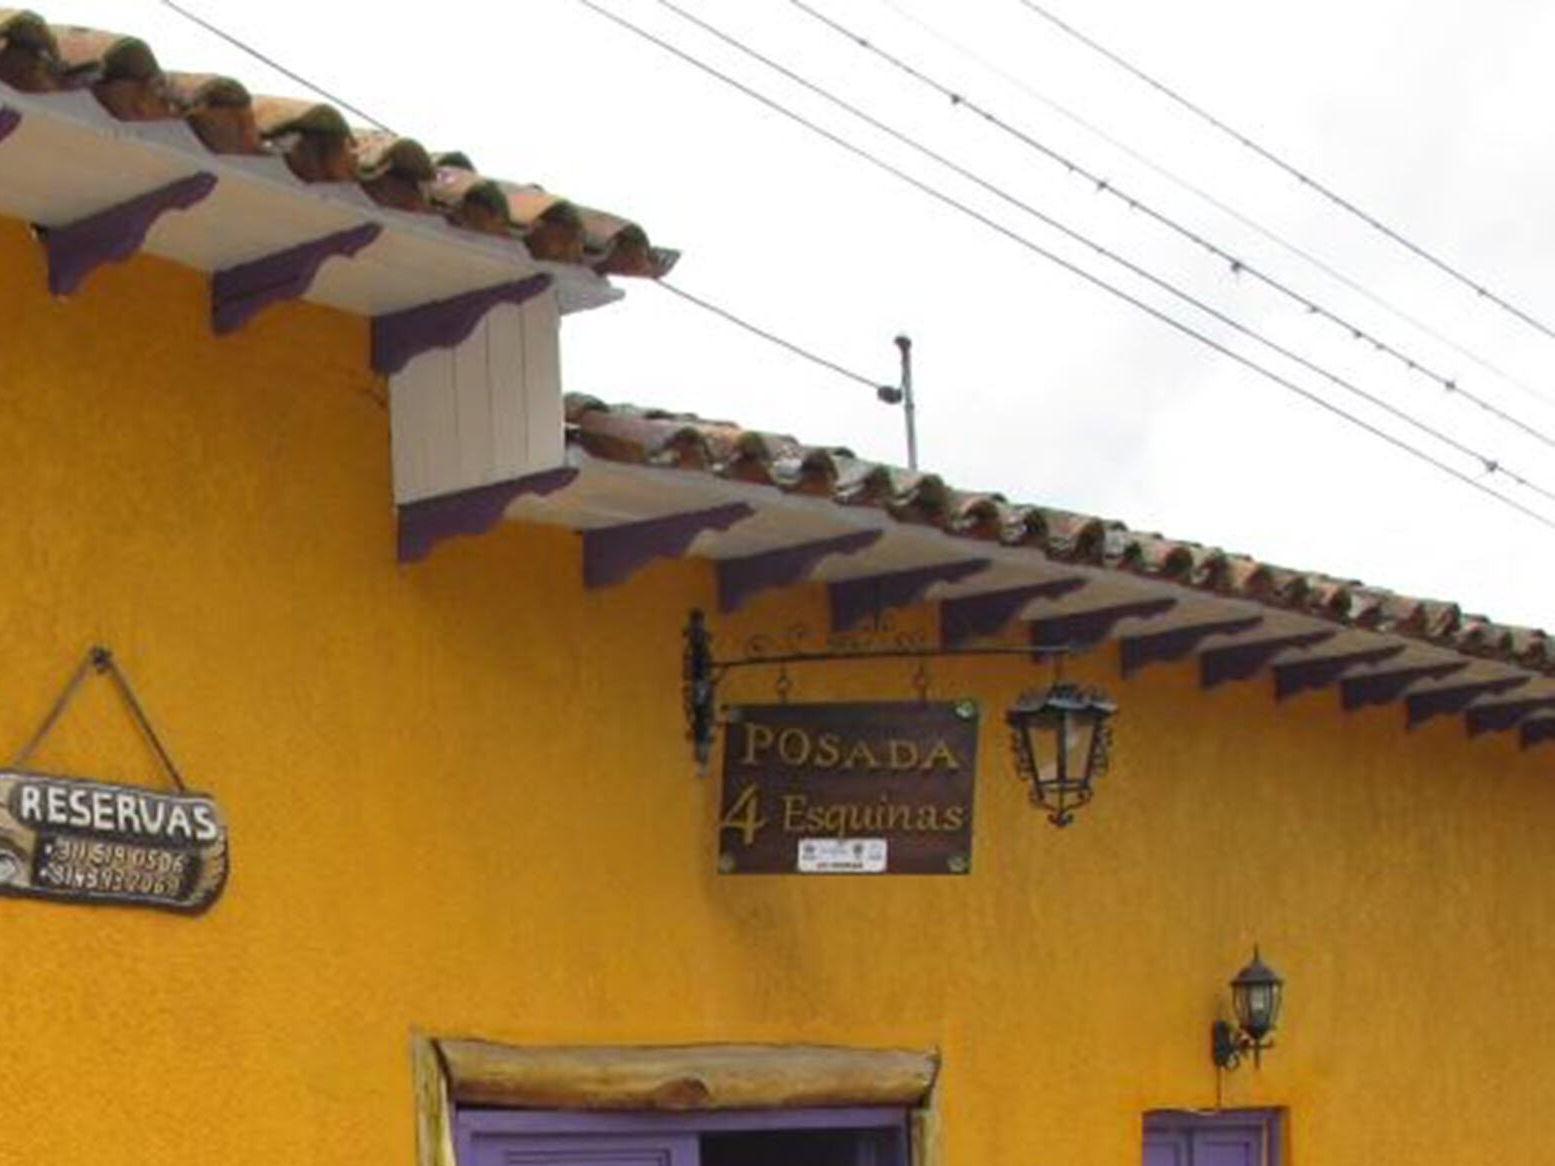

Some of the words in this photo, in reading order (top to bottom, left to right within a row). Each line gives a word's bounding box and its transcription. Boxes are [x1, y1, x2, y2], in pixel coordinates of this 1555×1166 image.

[741, 721, 961, 770] POSADA
[20, 785, 218, 841] RESERVAS
[720, 778, 767, 846] 4
[779, 794, 964, 838] Esquinas
